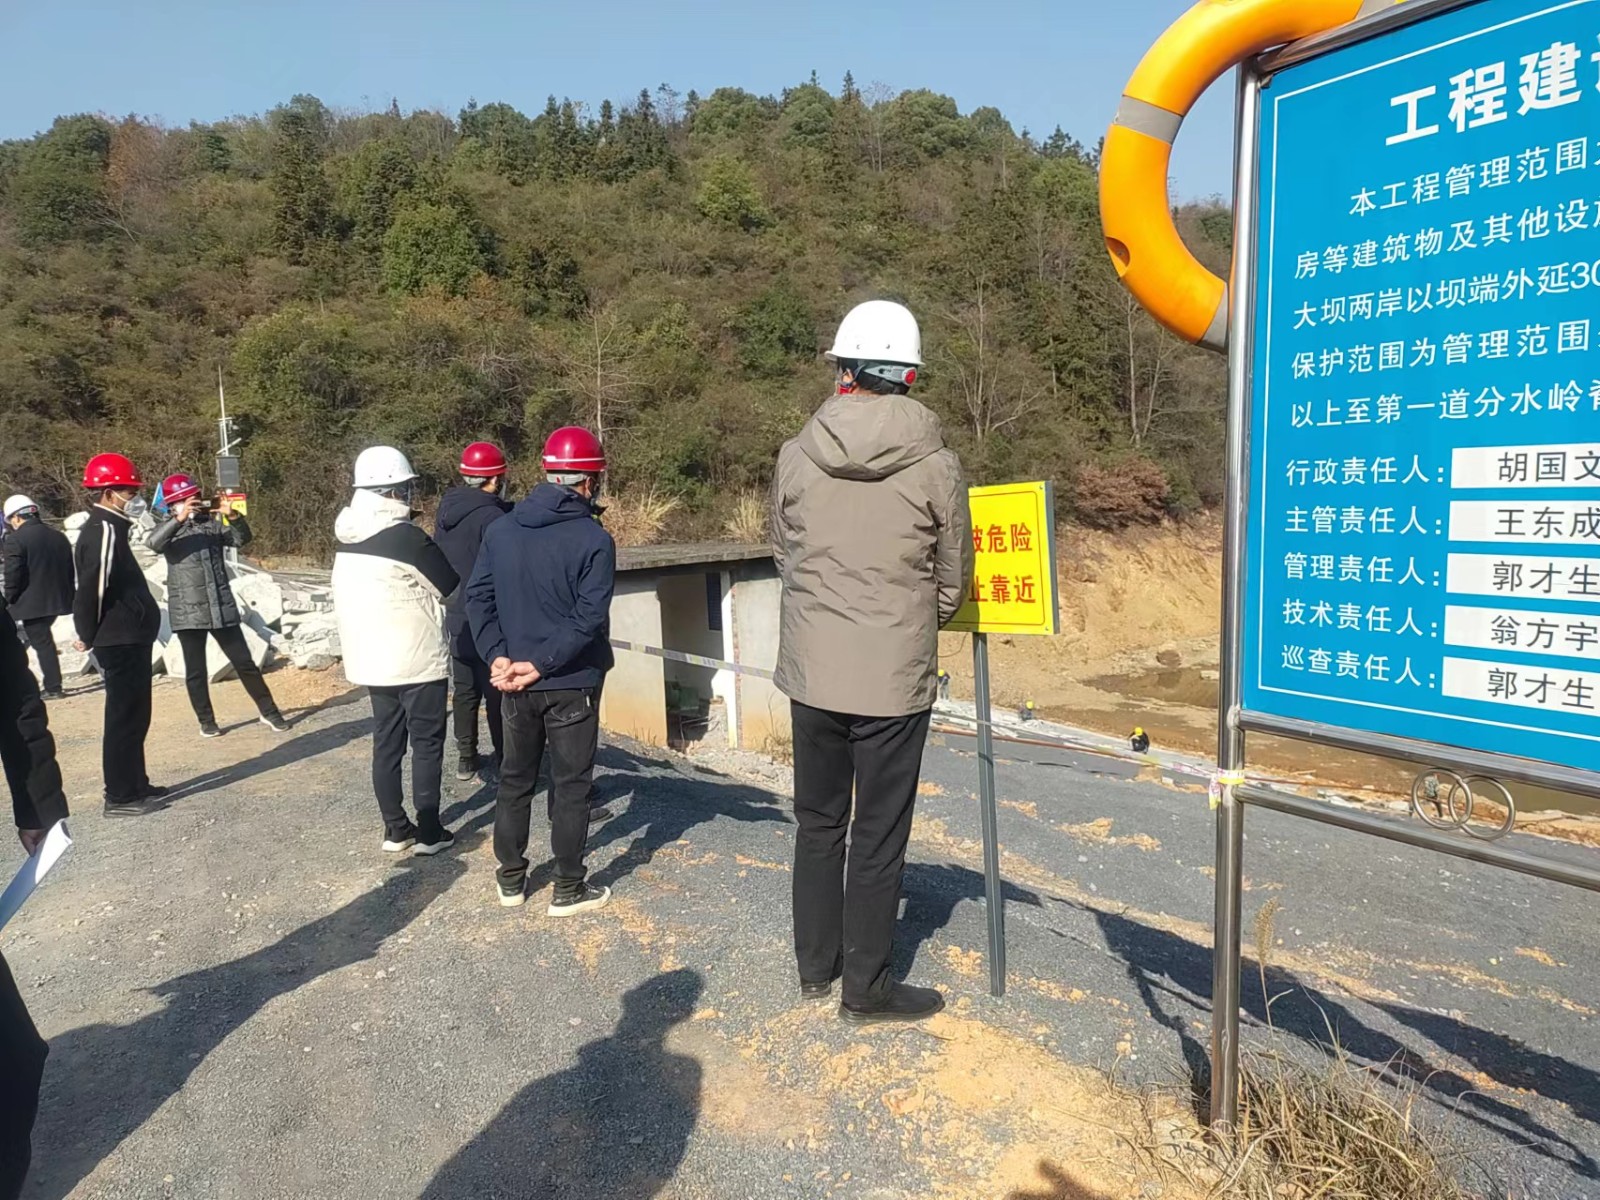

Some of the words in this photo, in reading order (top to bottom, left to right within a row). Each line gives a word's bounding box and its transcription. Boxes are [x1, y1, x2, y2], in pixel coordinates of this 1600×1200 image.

[1385, 32, 1600, 146] 工程建
[1349, 136, 1600, 217] 本工程管理范围
[1294, 196, 1600, 279] 房等建筑物及其他设
[1292, 319, 1600, 380] 保护范围为管理范围
[1286, 454, 1444, 486] 行政责任人：
[1497, 450, 1600, 482] 胡国文
[1284, 505, 1442, 535] 主管责任人：
[1494, 506, 1600, 539] 王东成
[968, 574, 1036, 604] 止靠近
[1284, 552, 1440, 587] 管理责任人：
[1492, 560, 1600, 596] 郭才生
[1282, 598, 1437, 638] 技术责任人：
[1490, 614, 1599, 652] 翁方宇
[1281, 644, 1435, 689] 巡查责任人：
[1487, 667, 1595, 710] 郭才生
